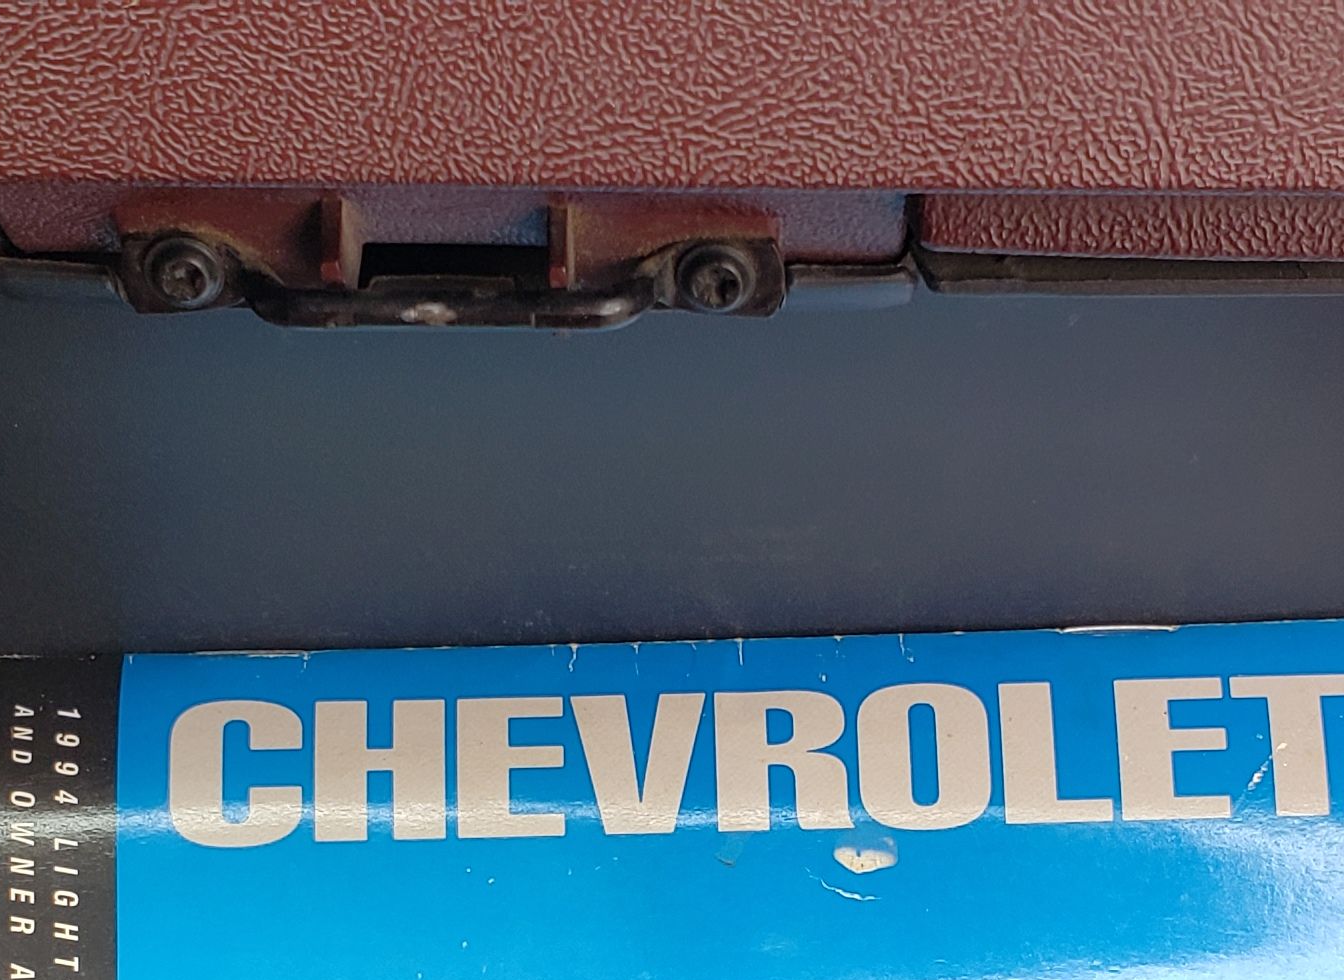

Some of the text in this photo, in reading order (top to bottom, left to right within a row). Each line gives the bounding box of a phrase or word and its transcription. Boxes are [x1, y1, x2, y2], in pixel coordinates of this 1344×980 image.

[10, 704, 35, 765] AND
[54, 705, 82, 806] 1994
[9, 790, 36, 935] OWNER
